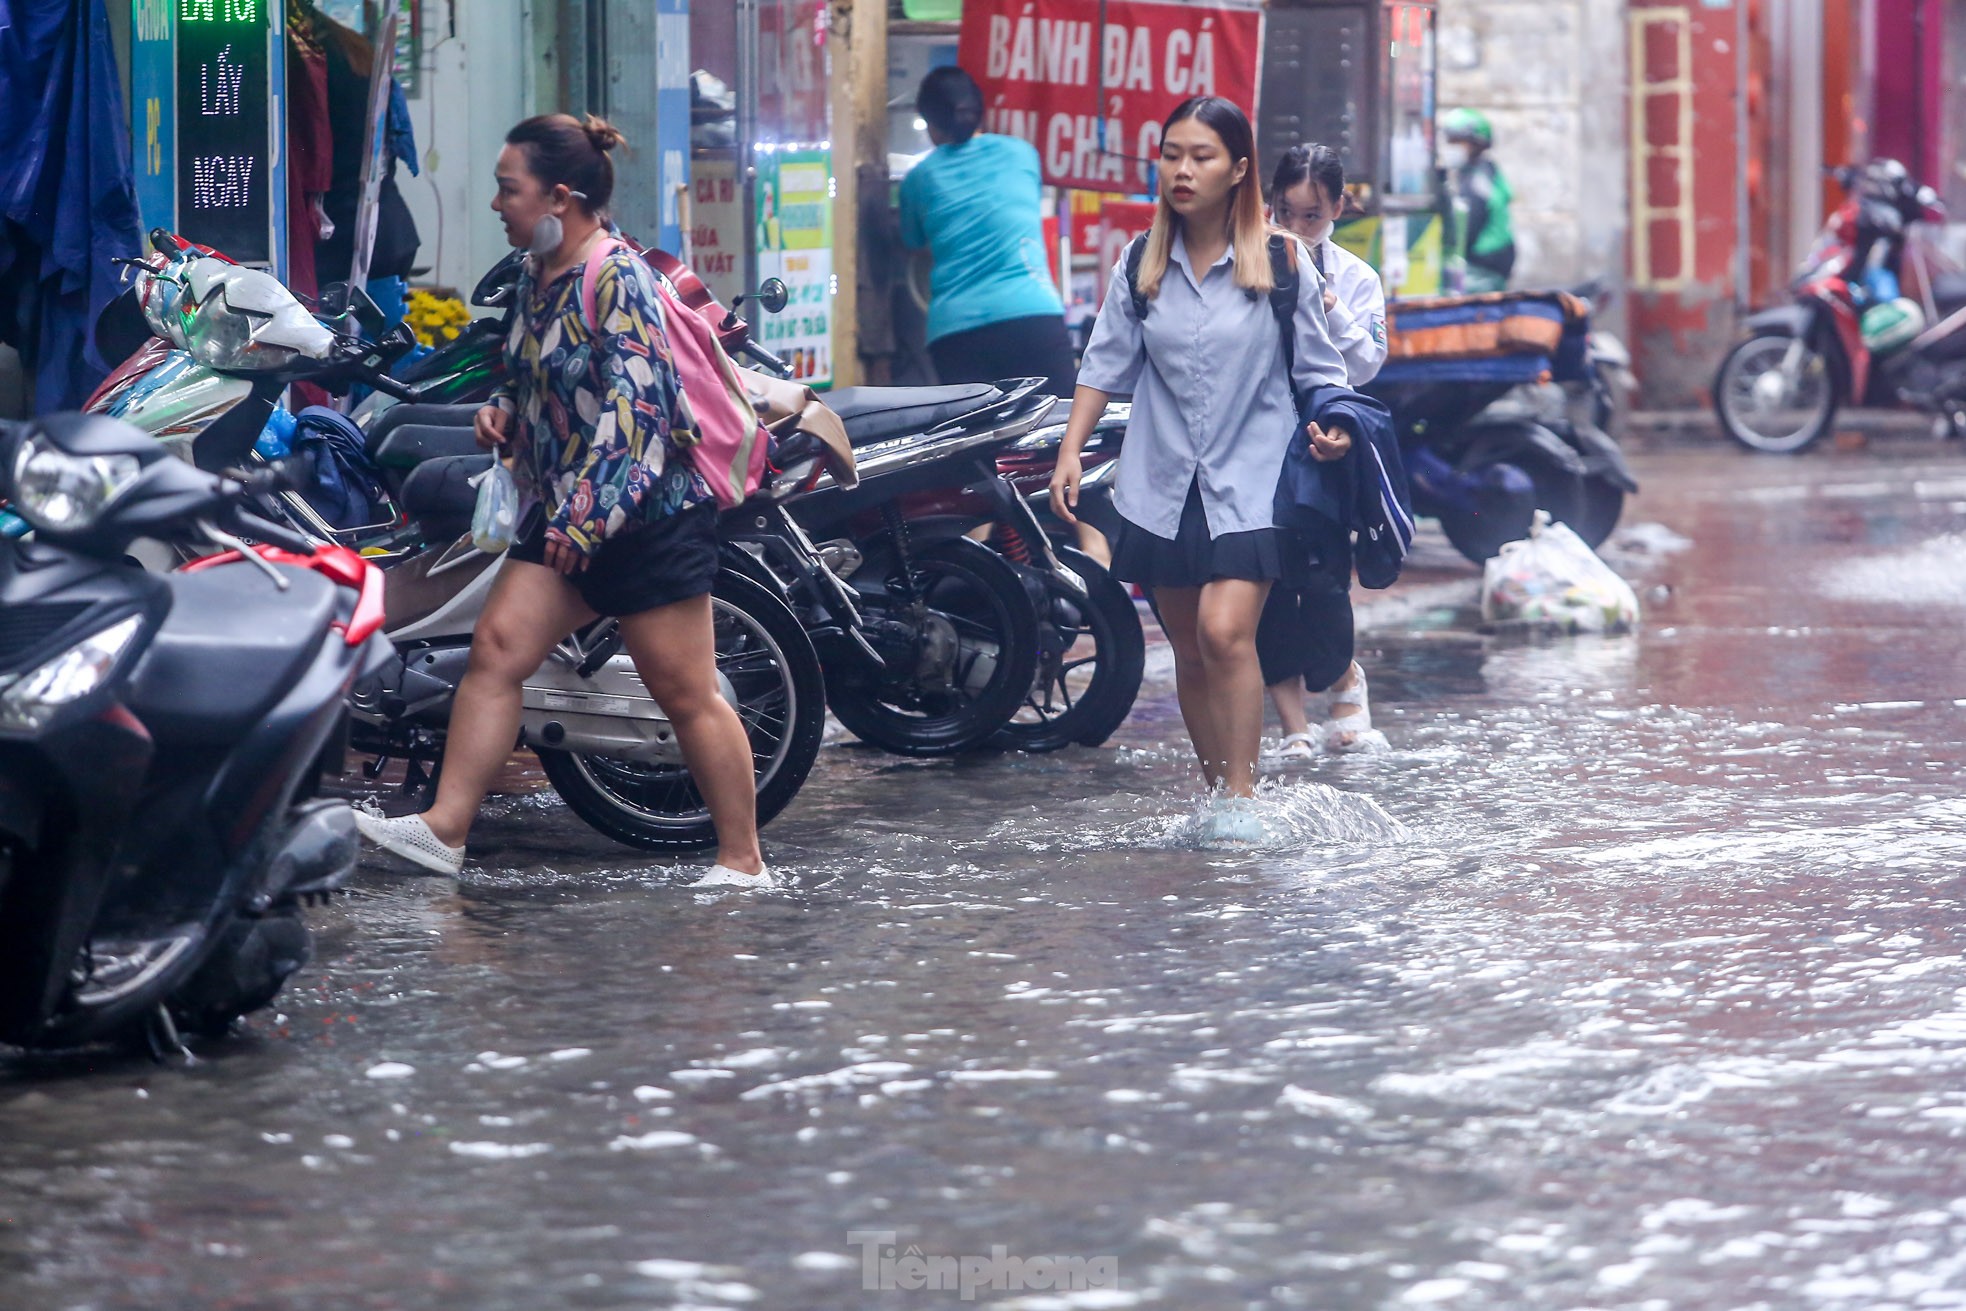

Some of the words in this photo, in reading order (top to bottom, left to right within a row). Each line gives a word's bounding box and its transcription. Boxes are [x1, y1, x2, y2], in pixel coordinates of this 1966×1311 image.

[201, 43, 243, 116] LẤY
[986, 3, 1091, 87] BÁNH
[1102, 26, 1152, 92] ĐA
[1164, 18, 1215, 96] CÁ
[986, 93, 1039, 147] ÚN
[1046, 95, 1125, 183] CHẢ
[194, 155, 254, 209] NGAY
